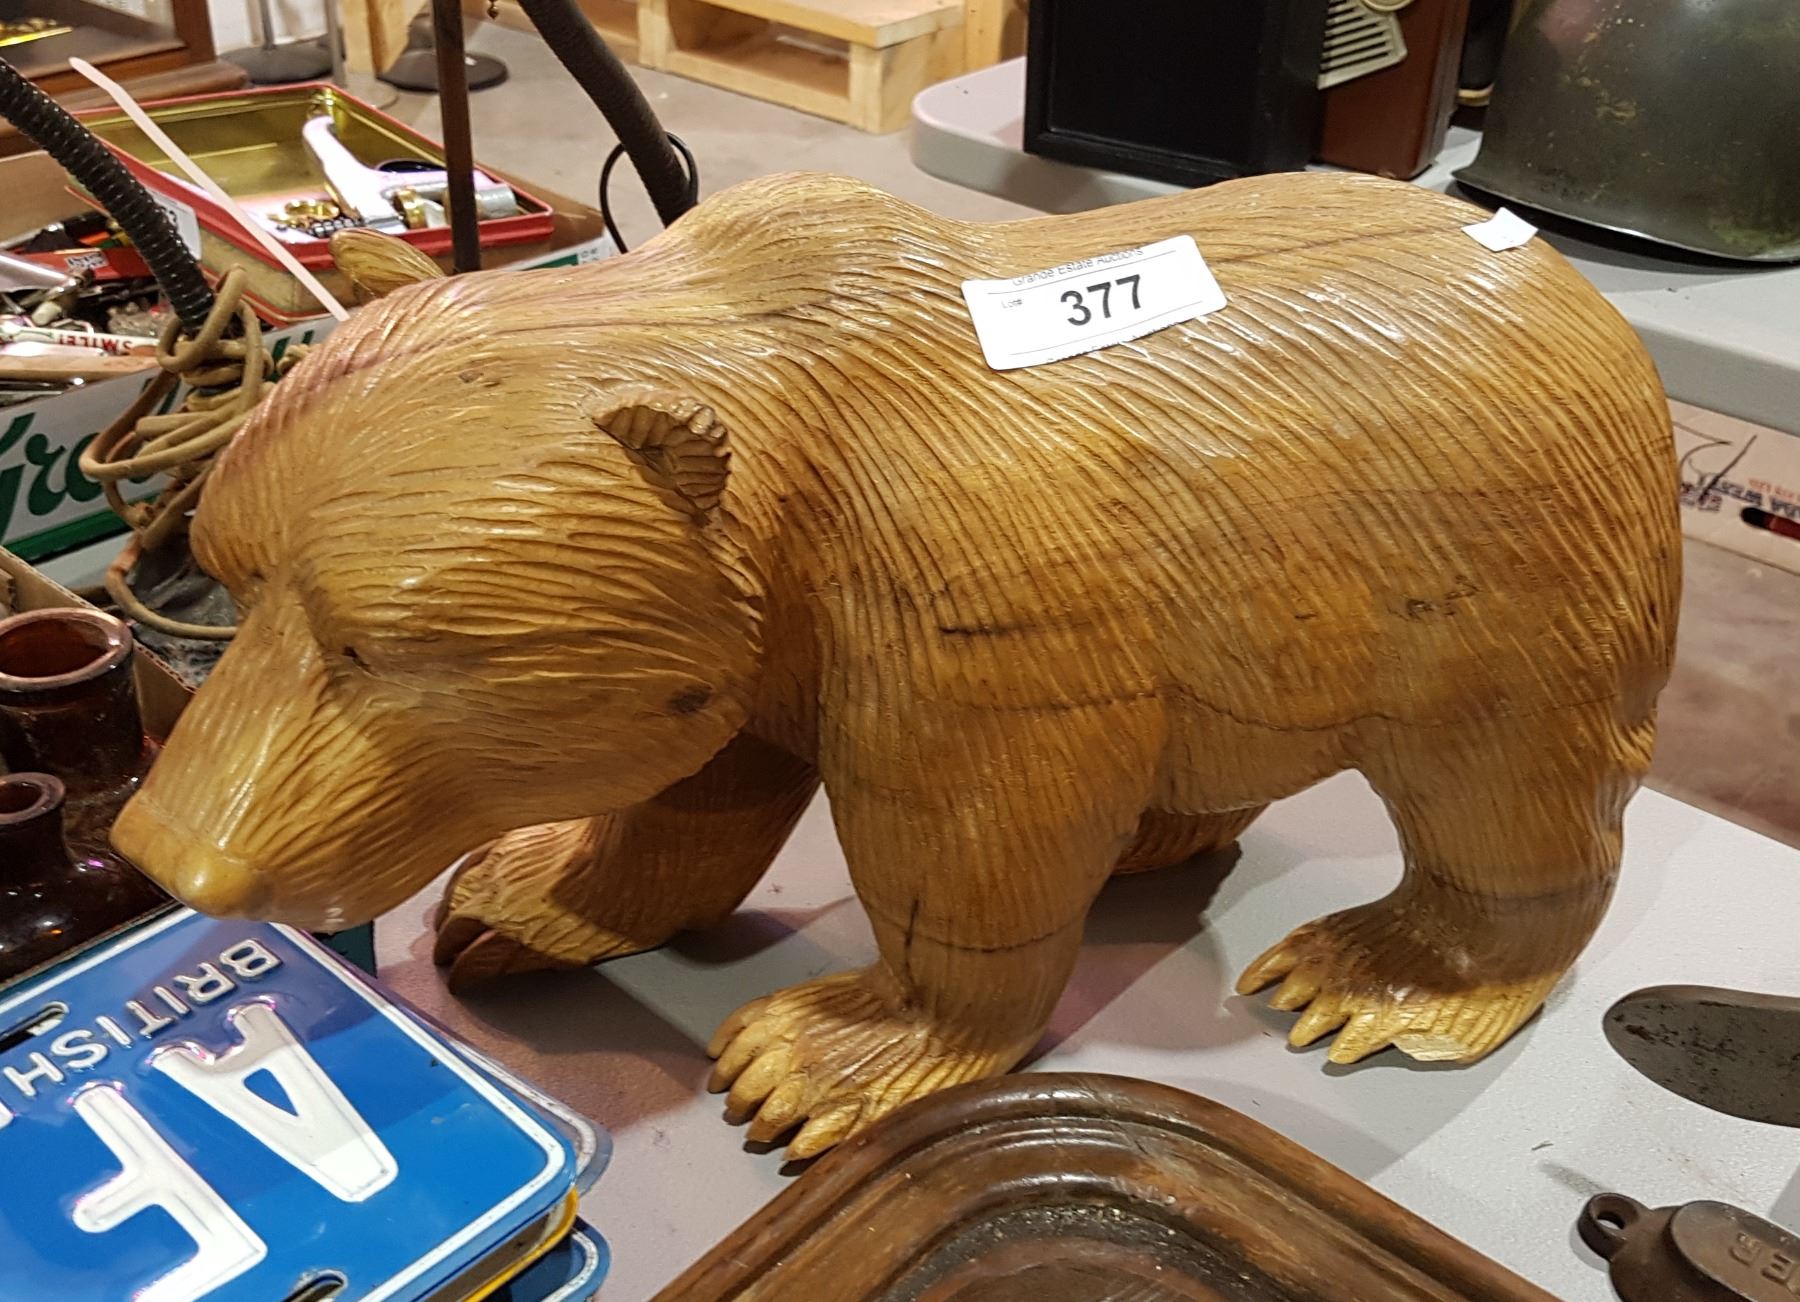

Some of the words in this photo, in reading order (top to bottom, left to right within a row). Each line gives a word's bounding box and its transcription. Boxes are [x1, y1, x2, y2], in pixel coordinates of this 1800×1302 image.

[1012, 267, 1055, 286] Grande
[1058, 257, 1095, 275] Estate
[1060, 274, 1141, 326] 377
[3, 938, 283, 1097] BRITISH
[0, 996, 399, 1302] AF
